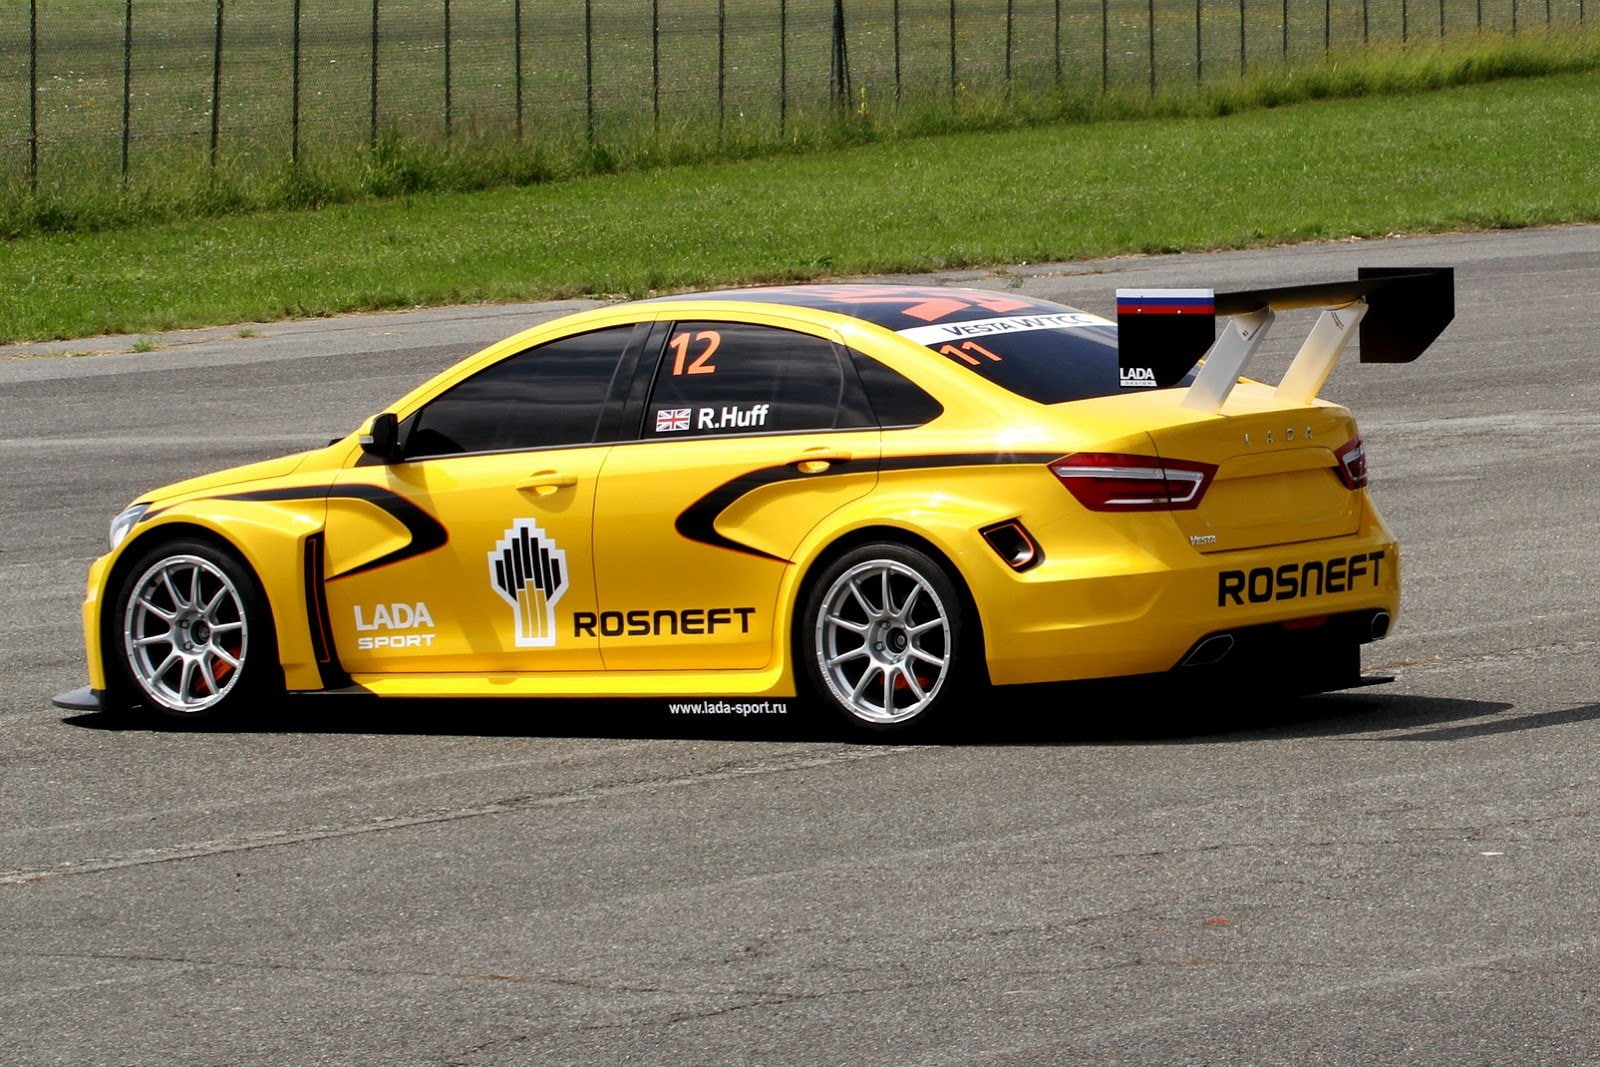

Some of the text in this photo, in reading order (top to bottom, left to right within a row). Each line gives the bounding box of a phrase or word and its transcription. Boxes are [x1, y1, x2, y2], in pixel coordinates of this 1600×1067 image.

[943, 314, 1093, 336] VESTA WTCC
[669, 330, 721, 376] 12
[940, 341, 1003, 366] 11
[1120, 367, 1155, 380] LADA
[698, 404, 769, 430] R.Huff
[1217, 550, 1385, 607] ROSNEFT
[353, 602, 435, 631] LADA
[572, 607, 756, 638] ROSNEFT
[357, 634, 436, 650] SPORT
[668, 700, 788, 717] www.lada-sport.ru
